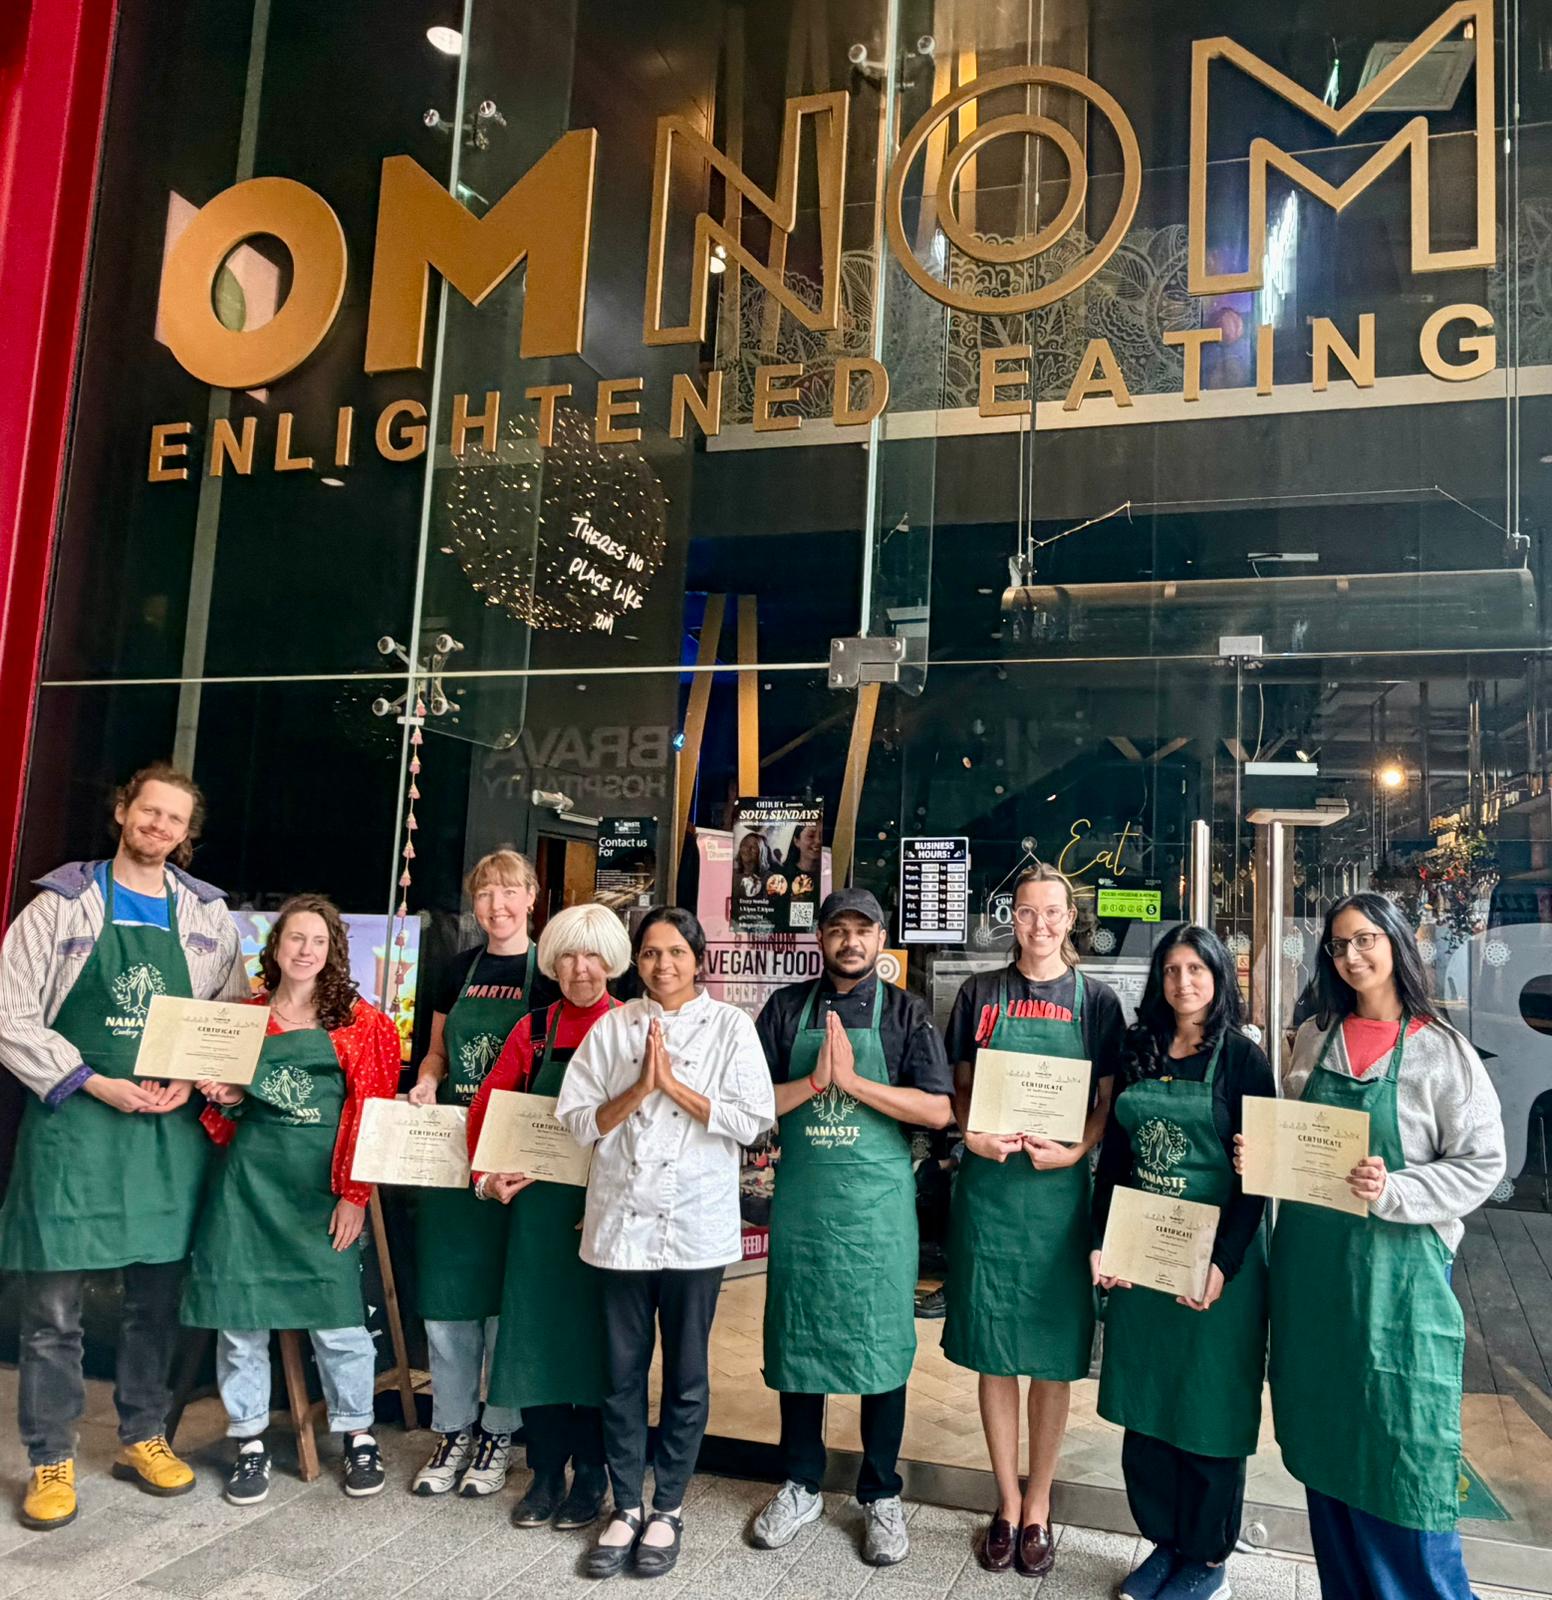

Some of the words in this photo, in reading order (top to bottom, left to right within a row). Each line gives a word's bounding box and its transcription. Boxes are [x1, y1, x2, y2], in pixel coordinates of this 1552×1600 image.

[148, 357, 889, 483] ENLIGHTENED
[979, 303, 1497, 418] EATING
[627, 552, 645, 573] NO
[568, 557, 613, 592] PLACE
[613, 579, 644, 610] LIKE
[739, 809, 769, 820] SOUL
[769, 809, 820, 821] SUNDAYS
[598, 836, 636, 848] Contact
[636, 839, 648, 848] us
[914, 841, 955, 850] BUSINESS
[1058, 818, 1141, 877] Eat
[598, 847, 615, 857] For
[917, 850, 951, 859] HOURS:
[707, 949, 767, 976] VEGAN
[772, 950, 821, 976] FOOD
[465, 984, 523, 1000] MARTIN
[105, 1015, 145, 1028] NAMA
[197, 1026, 241, 1036] CERTIFICATE
[1021, 1080, 1064, 1092] CERTIFICATE
[409, 1129, 452, 1139] CERTIFICATE
[805, 1125, 861, 1138] NAMASTE
[1297, 1134, 1342, 1149] CERTIFICATE
[1137, 1166, 1188, 1189] NAMASTE
[1155, 1225, 1193, 1240] CERTIFICATE
